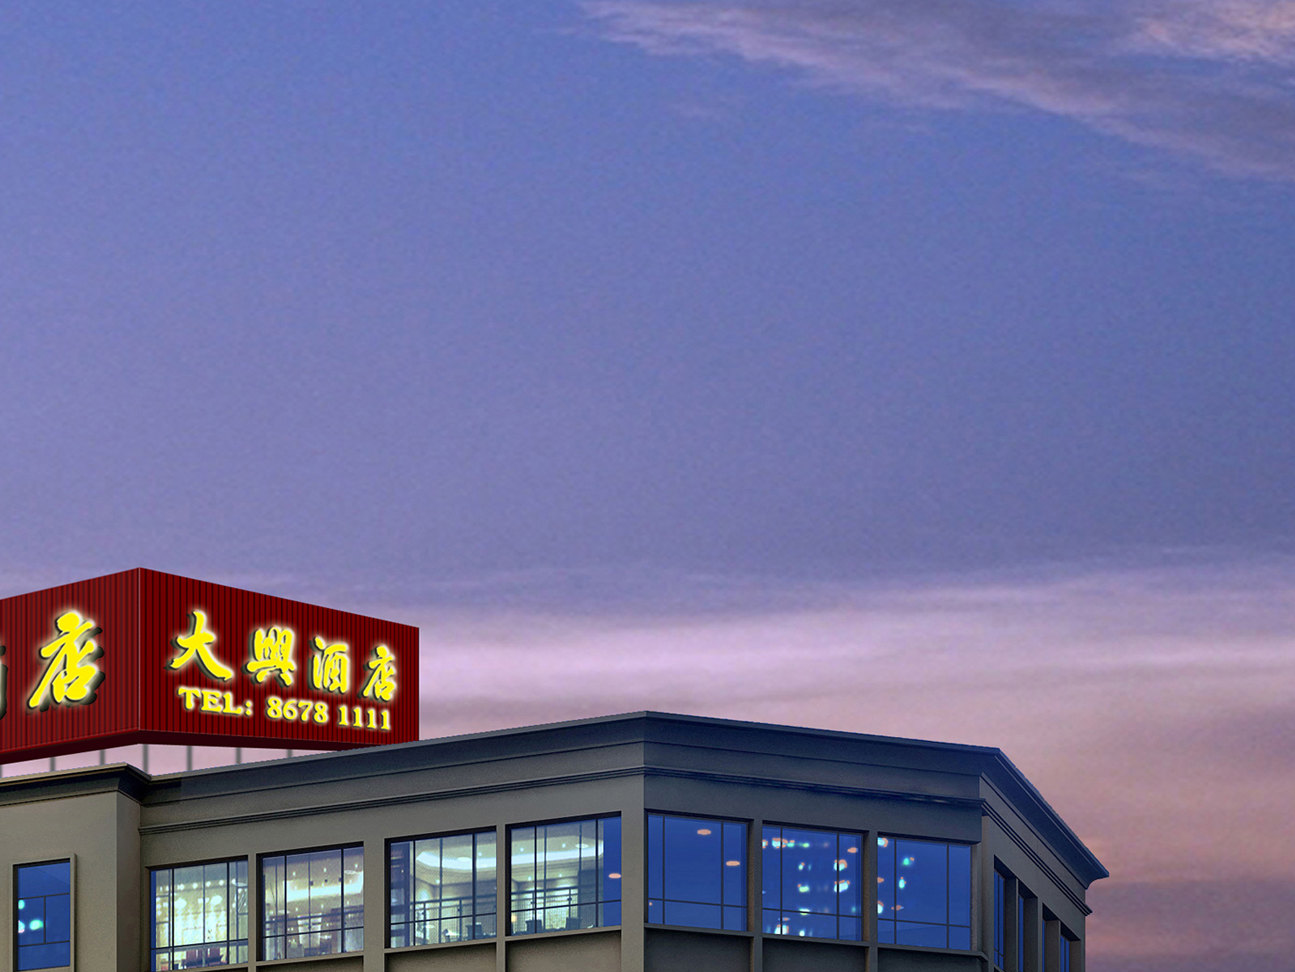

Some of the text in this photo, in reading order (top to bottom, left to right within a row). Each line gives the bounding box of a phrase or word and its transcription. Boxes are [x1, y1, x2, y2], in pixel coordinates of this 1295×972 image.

[169, 609, 398, 703] 大興酒店
[178, 686, 391, 731] TEL: 8678 1111
